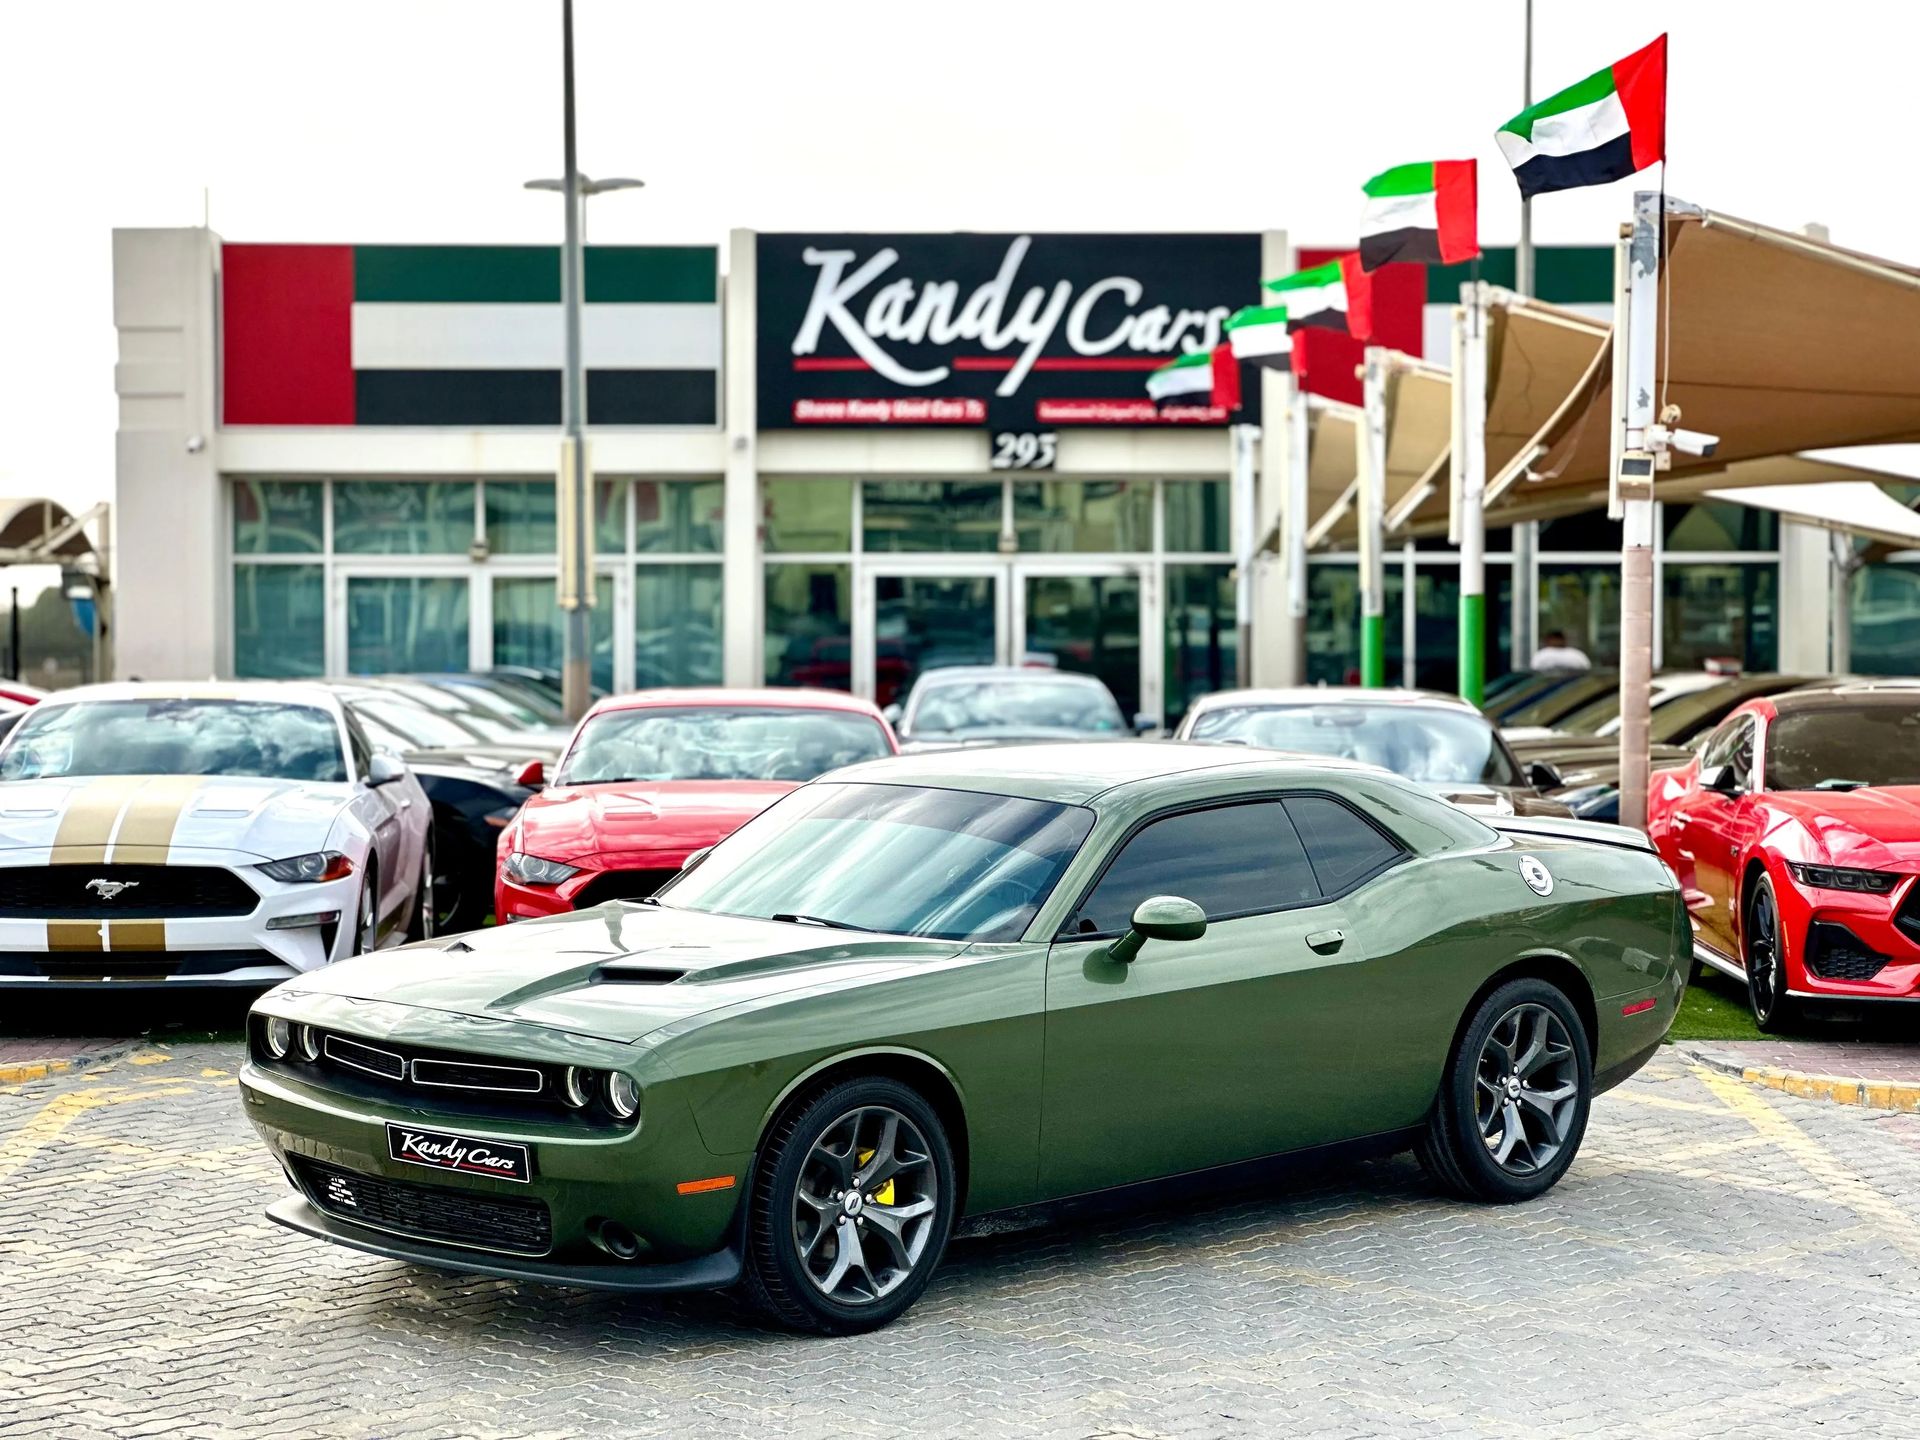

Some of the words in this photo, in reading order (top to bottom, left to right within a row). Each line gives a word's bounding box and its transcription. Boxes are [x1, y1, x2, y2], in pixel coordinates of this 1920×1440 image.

[791, 235, 1072, 396] Kandy
[1066, 276, 1230, 356] Cars
[991, 432, 1057, 469] 295
[401, 1132, 467, 1167] Kandy
[467, 1148, 515, 1169] Cars
